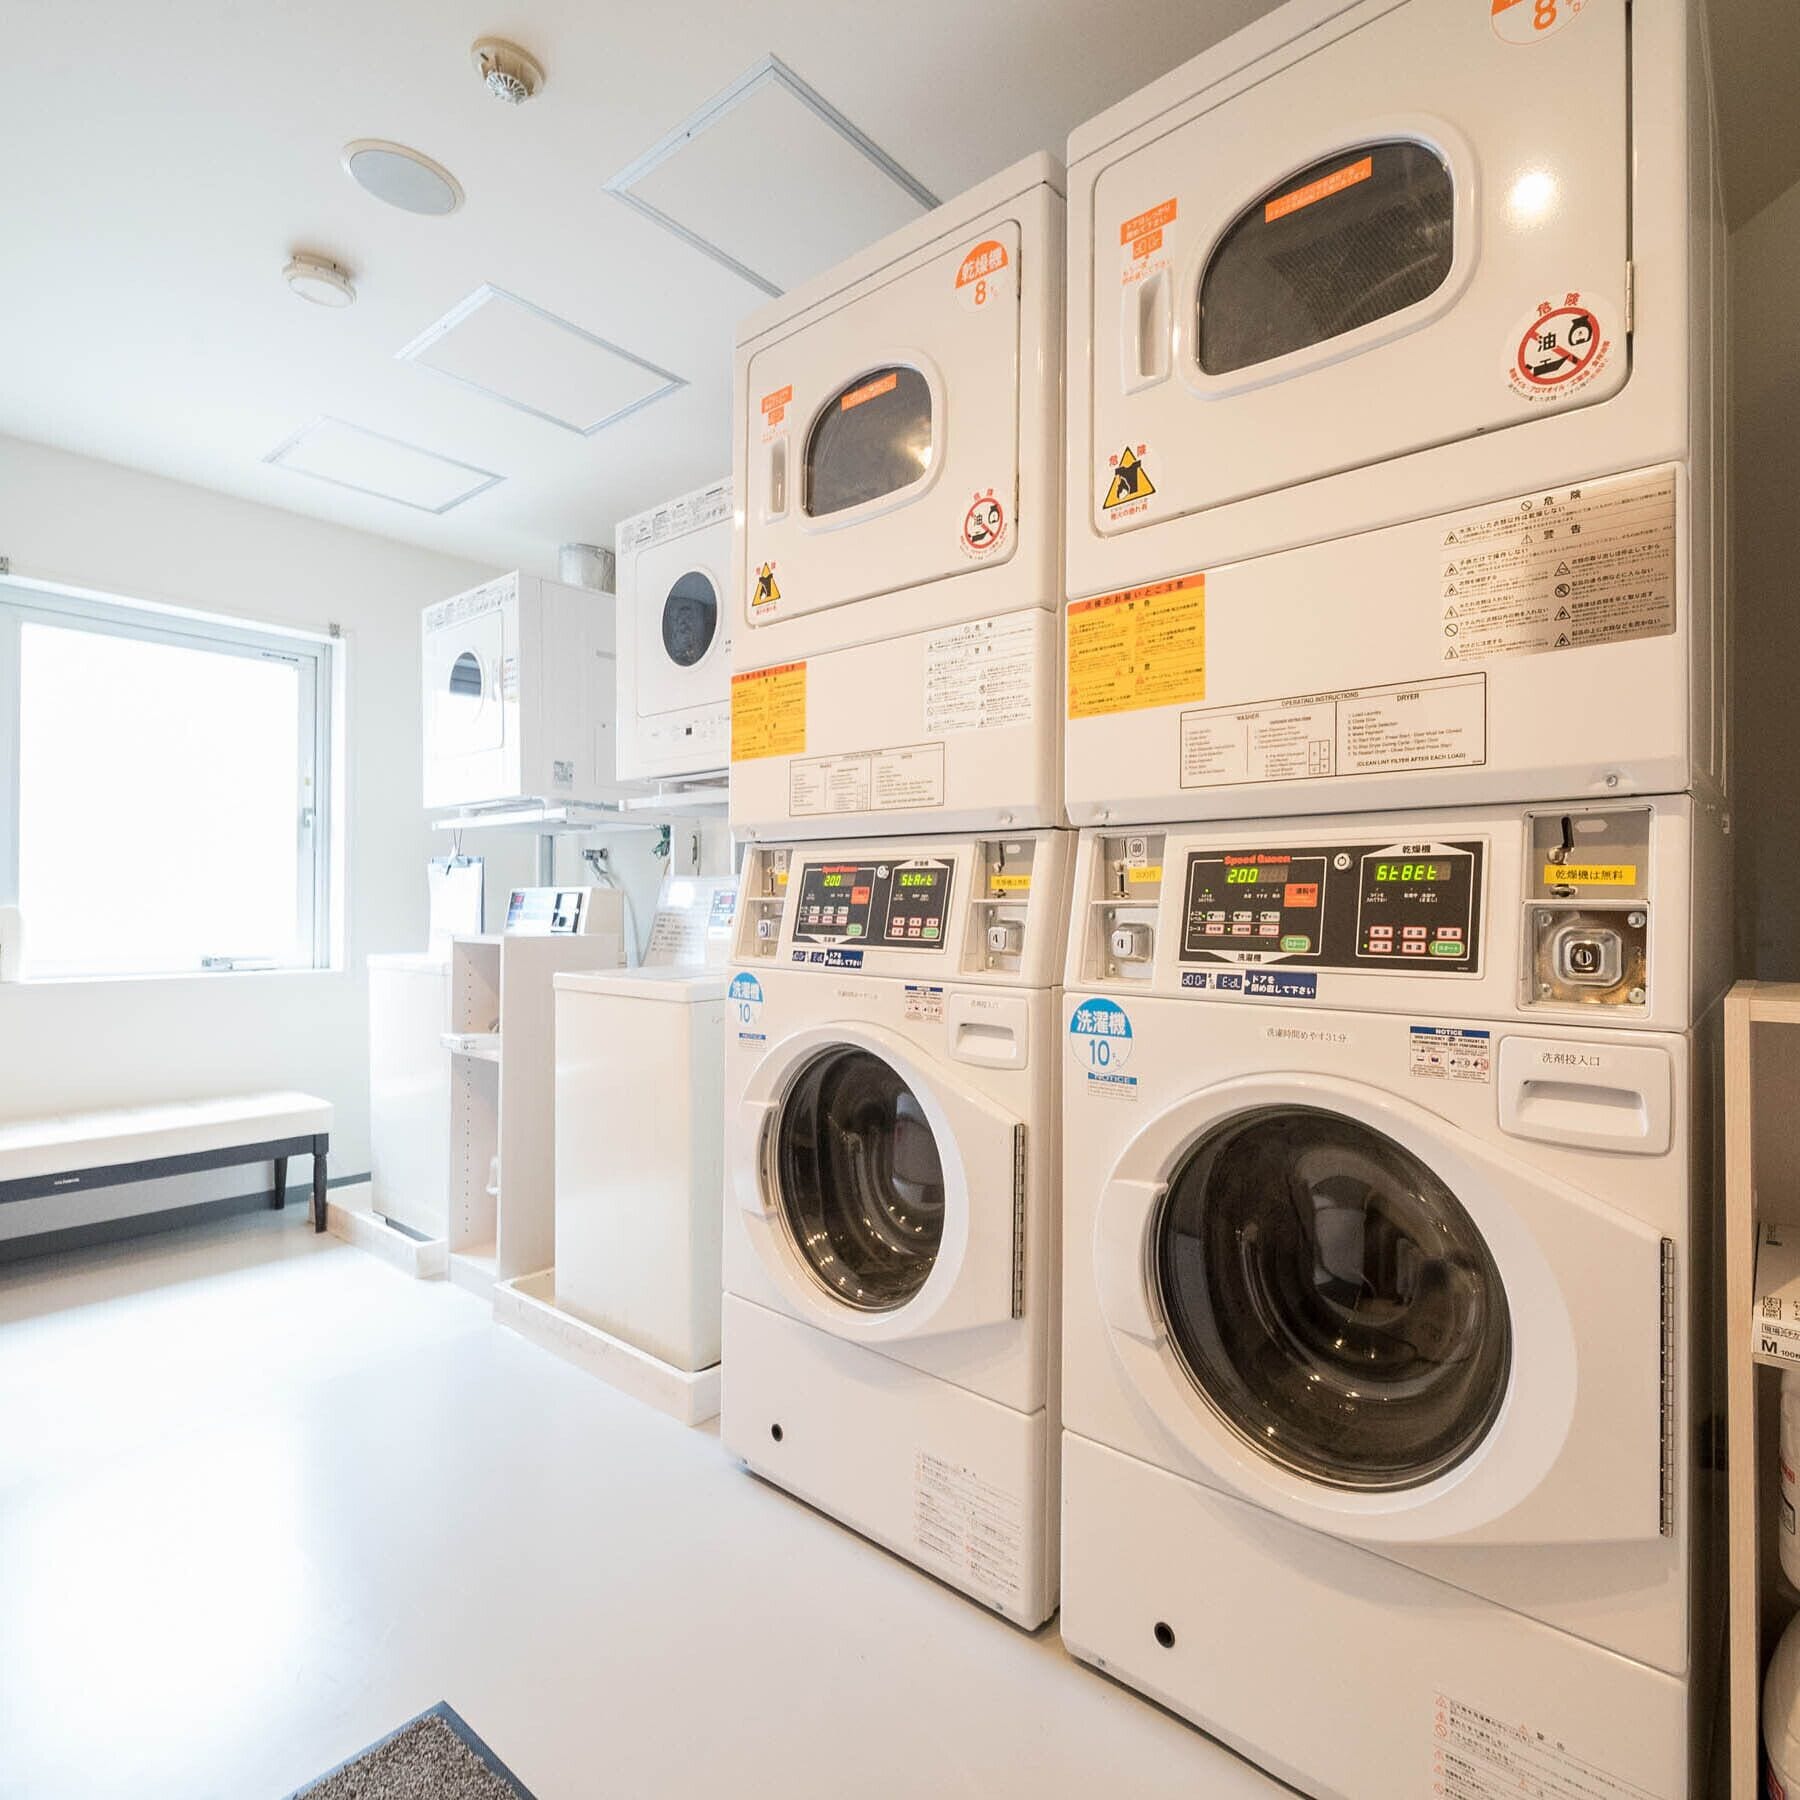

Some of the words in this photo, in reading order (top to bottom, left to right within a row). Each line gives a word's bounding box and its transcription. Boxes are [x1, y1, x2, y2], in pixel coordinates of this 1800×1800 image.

[1532, 0, 1556, 29] 8
[975, 280, 986, 304] 8
[1536, 332, 1557, 352] 油
[1543, 489, 1581, 506] 危険
[1281, 697, 1314, 707] OPERATING
[1315, 691, 1359, 703] INSTRUCTIONS
[1396, 693, 1420, 702] DRYER
[1402, 845, 1431, 853] 乾燥機
[1224, 855, 1256, 866] Speed
[1257, 854, 1291, 864] Queen
[824, 875, 842, 887] 200
[1227, 868, 1259, 883] 200
[1555, 869, 1623, 880] 乾燥機は無料
[1252, 975, 1275, 983] ドアを
[733, 981, 760, 1001] 洗濯機
[739, 1003, 751, 1023] 10
[1077, 1010, 1126, 1036] 洗濯機
[1435, 1028, 1463, 1036] NOTICE
[1089, 1039, 1110, 1066] 10
[1542, 1052, 1600, 1067] 洗剤投入口
[1094, 1073, 1130, 1083] NOTICE
[1761, 1339, 1777, 1354] M
